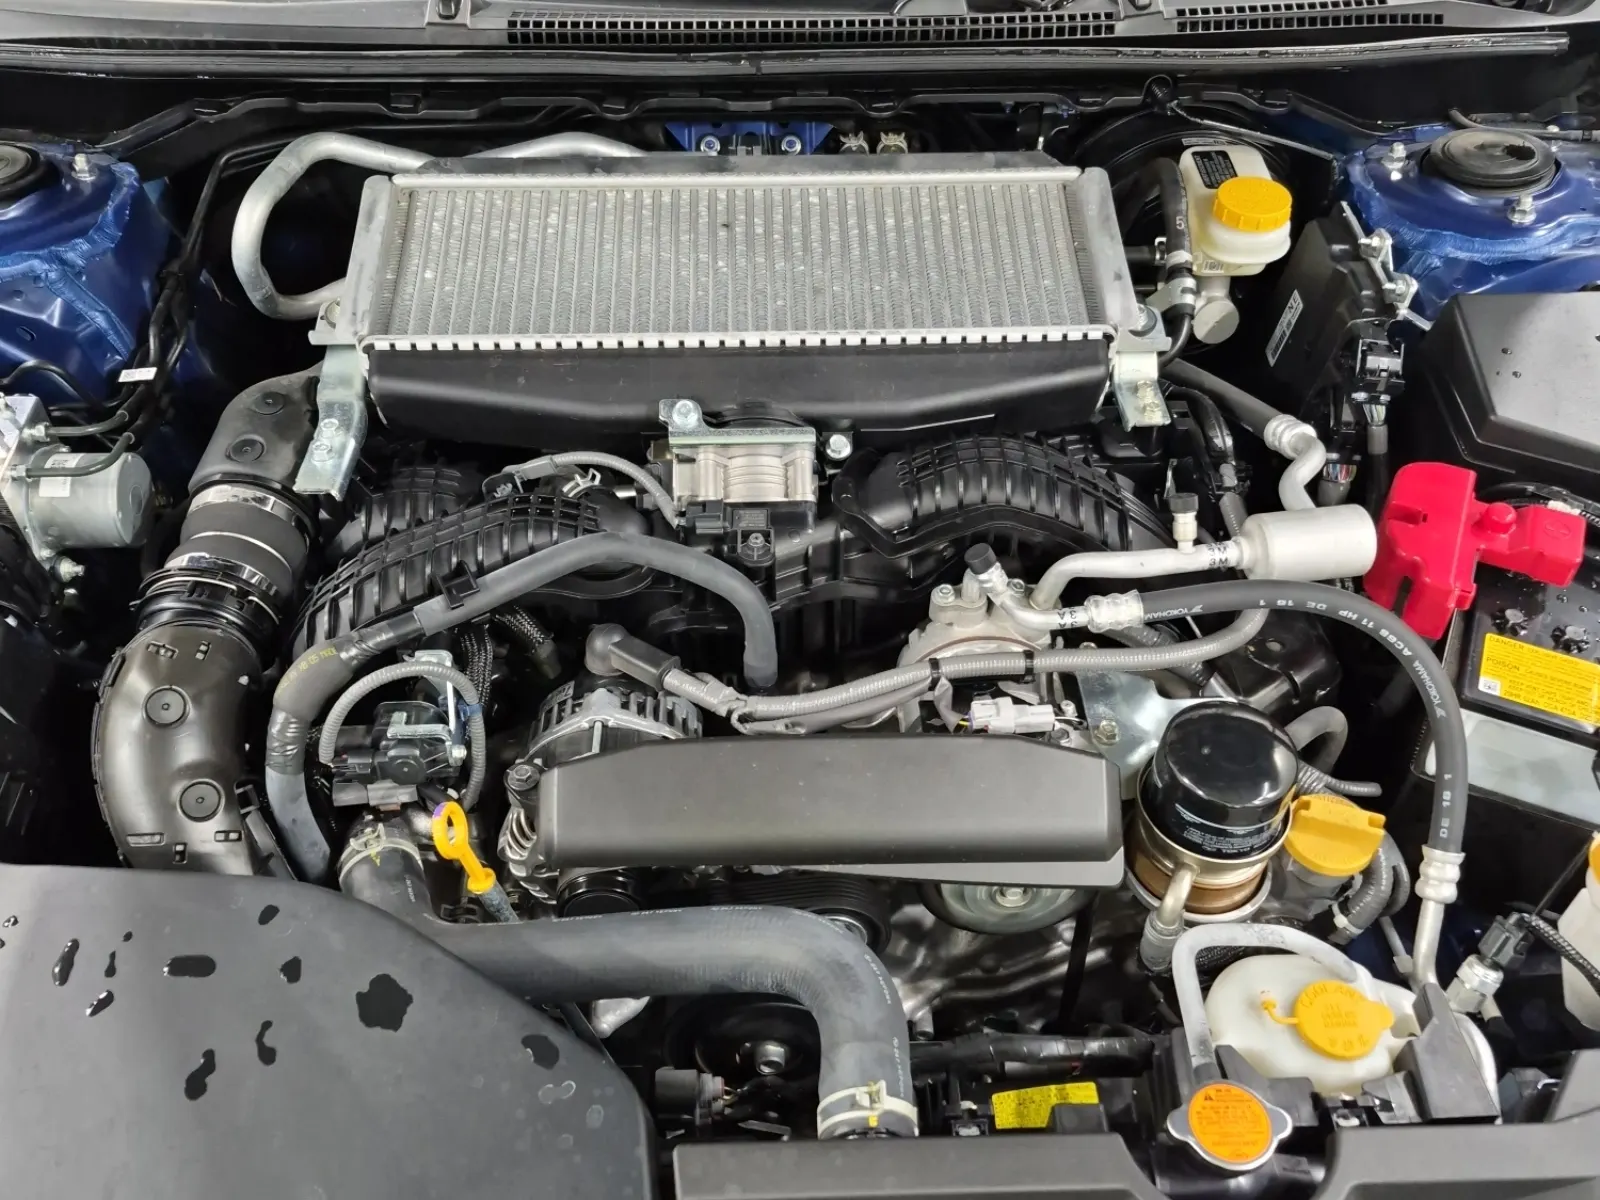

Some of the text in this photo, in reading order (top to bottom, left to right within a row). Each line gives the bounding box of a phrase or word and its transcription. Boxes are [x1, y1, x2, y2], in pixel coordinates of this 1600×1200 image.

[1175, 215, 1186, 230] 5
[1306, 601, 1328, 611] DE
[1338, 609, 1359, 621] HP
[1361, 618, 1375, 629] 11
[1489, 635, 1525, 651] DANGER
[1486, 656, 1520, 672] POISON
[1412, 660, 1441, 705] YOKOHAMA
